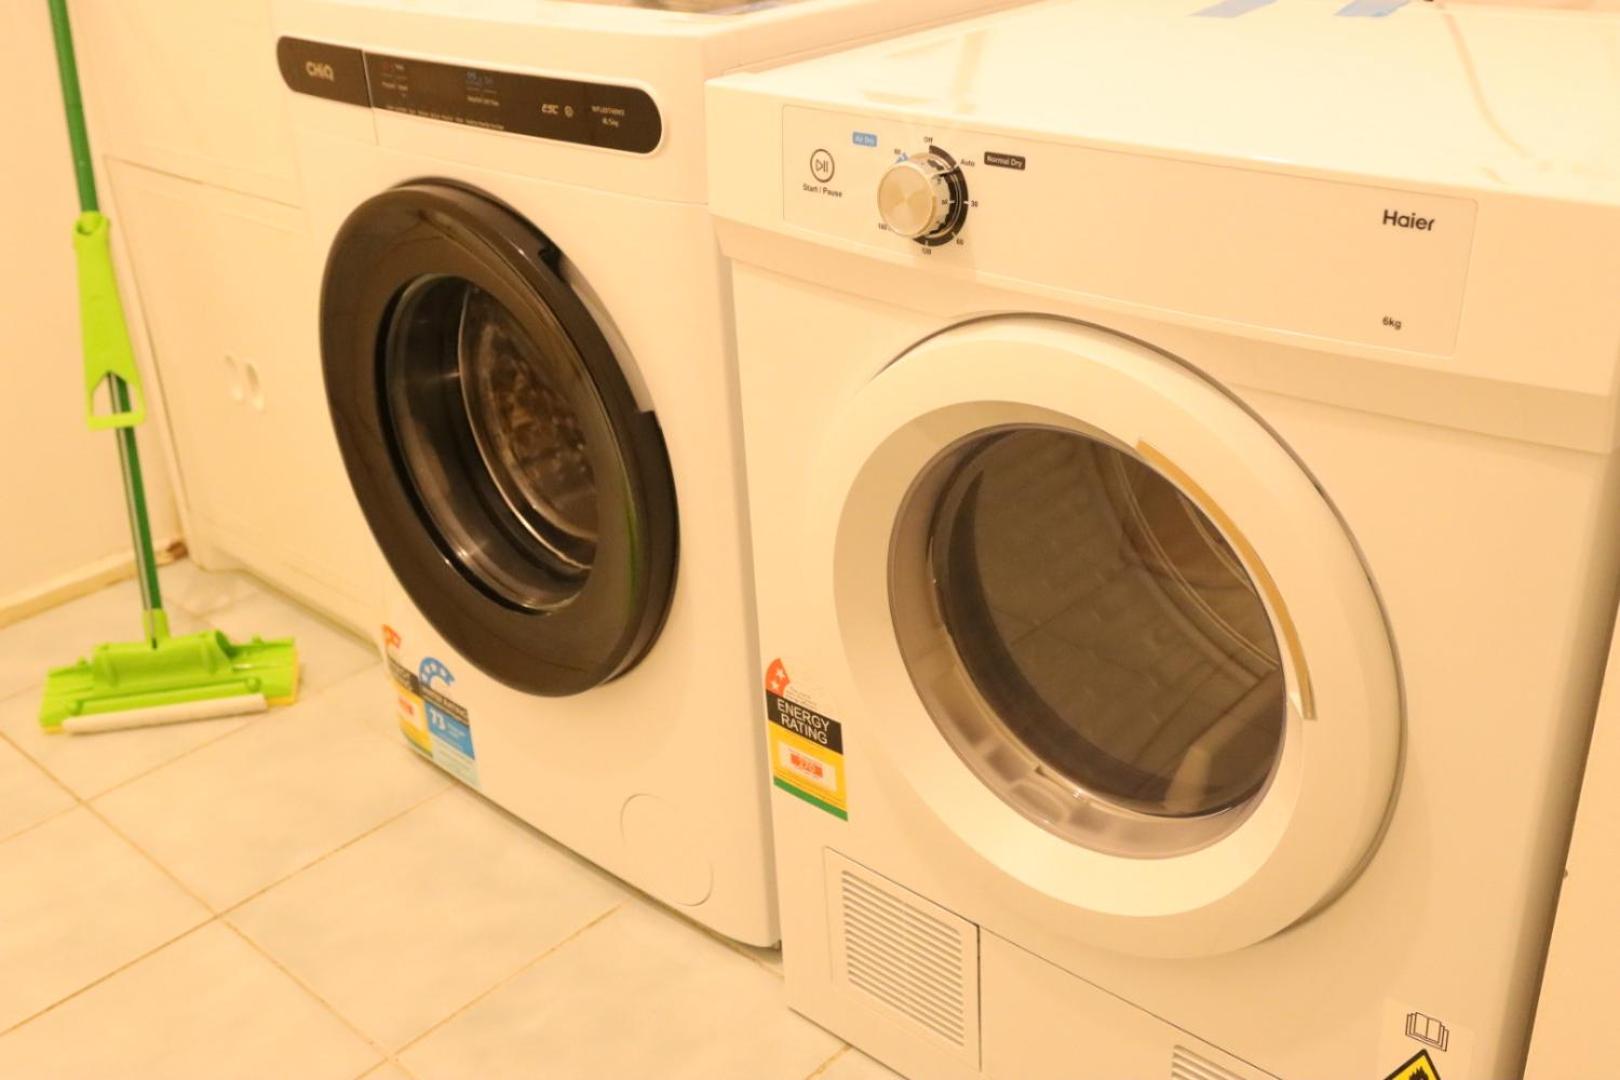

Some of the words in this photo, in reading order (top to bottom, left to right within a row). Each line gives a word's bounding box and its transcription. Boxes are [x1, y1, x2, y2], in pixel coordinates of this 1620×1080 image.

[960, 158, 975, 167] Auto
[986, 155, 1010, 166] Normal
[1010, 158, 1023, 169] Dry
[802, 183, 818, 193] Start
[822, 186, 843, 198] Pause
[1382, 209, 1435, 231] Haier
[1382, 316, 1402, 330] 6kg
[777, 698, 830, 732] ENERGY
[781, 712, 828, 745] RATING
